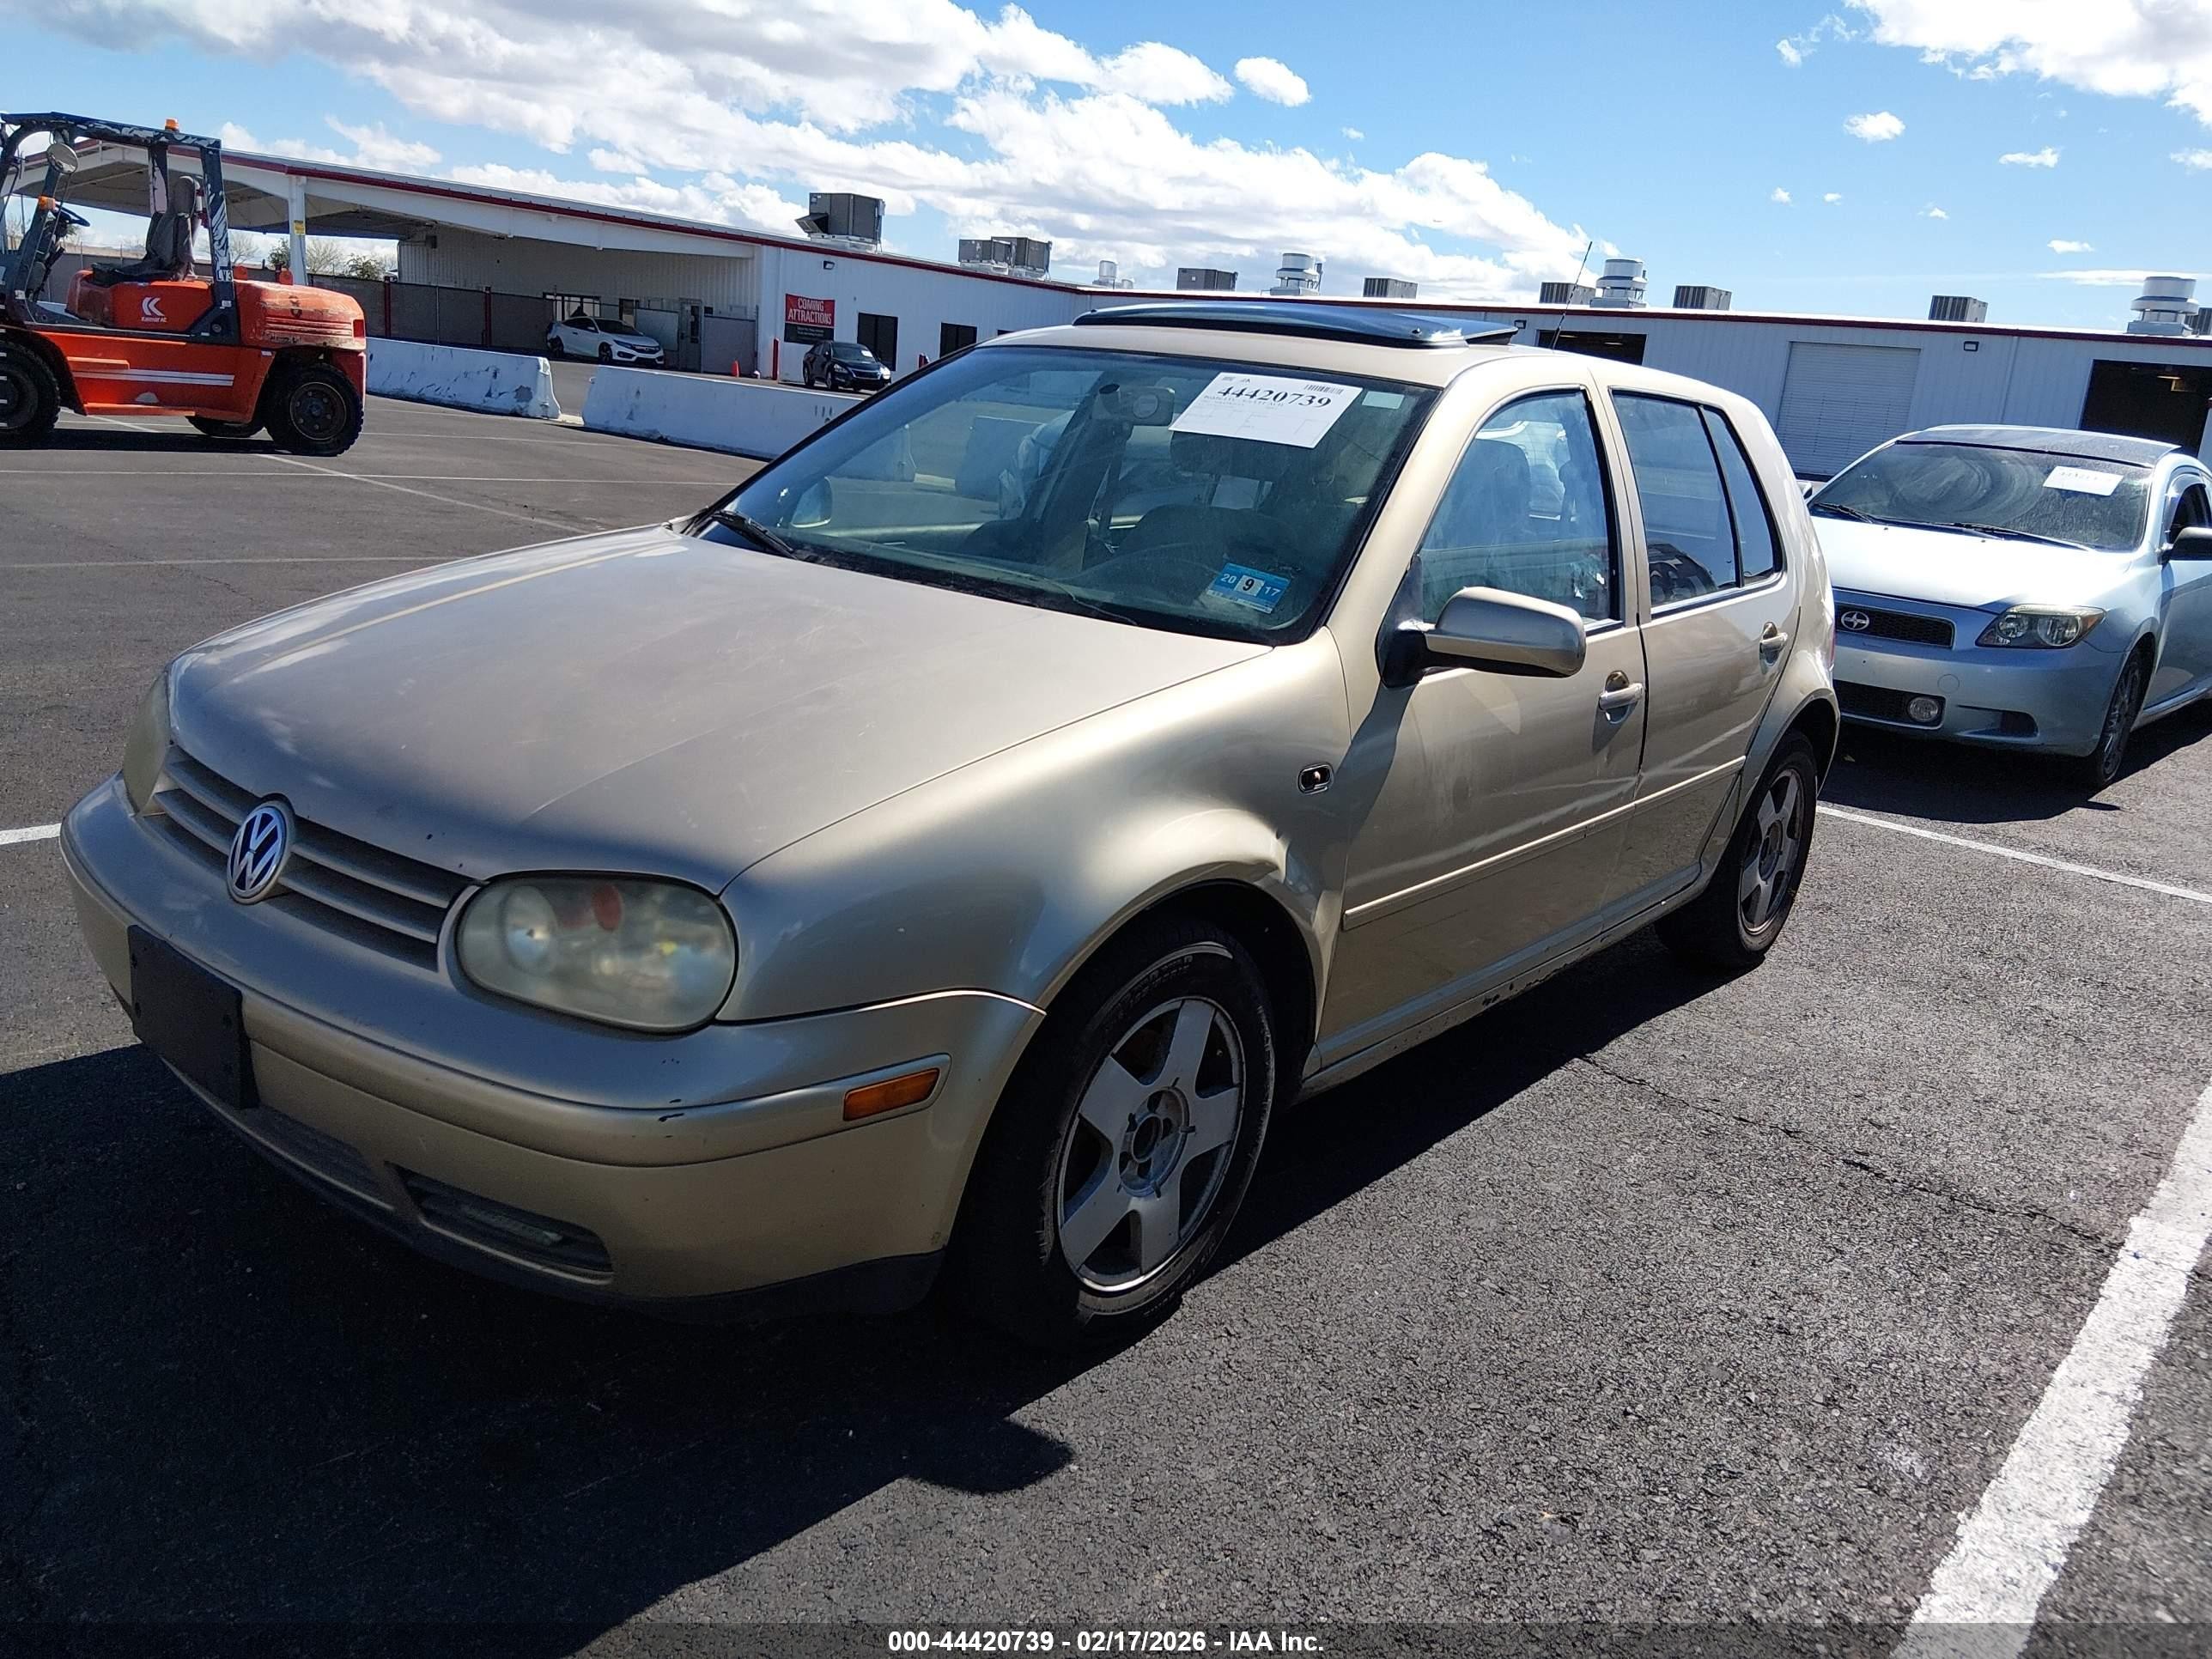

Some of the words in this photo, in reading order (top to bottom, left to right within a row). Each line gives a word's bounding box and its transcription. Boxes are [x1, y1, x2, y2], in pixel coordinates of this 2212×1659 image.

[798, 298, 824, 312] COMING
[788, 308, 831, 325] ATTRACTIONS
[1218, 386, 1332, 408] 44420739
[1220, 573, 1237, 584] 20
[1243, 578, 1255, 592] 9
[1264, 586, 1282, 597] 17
